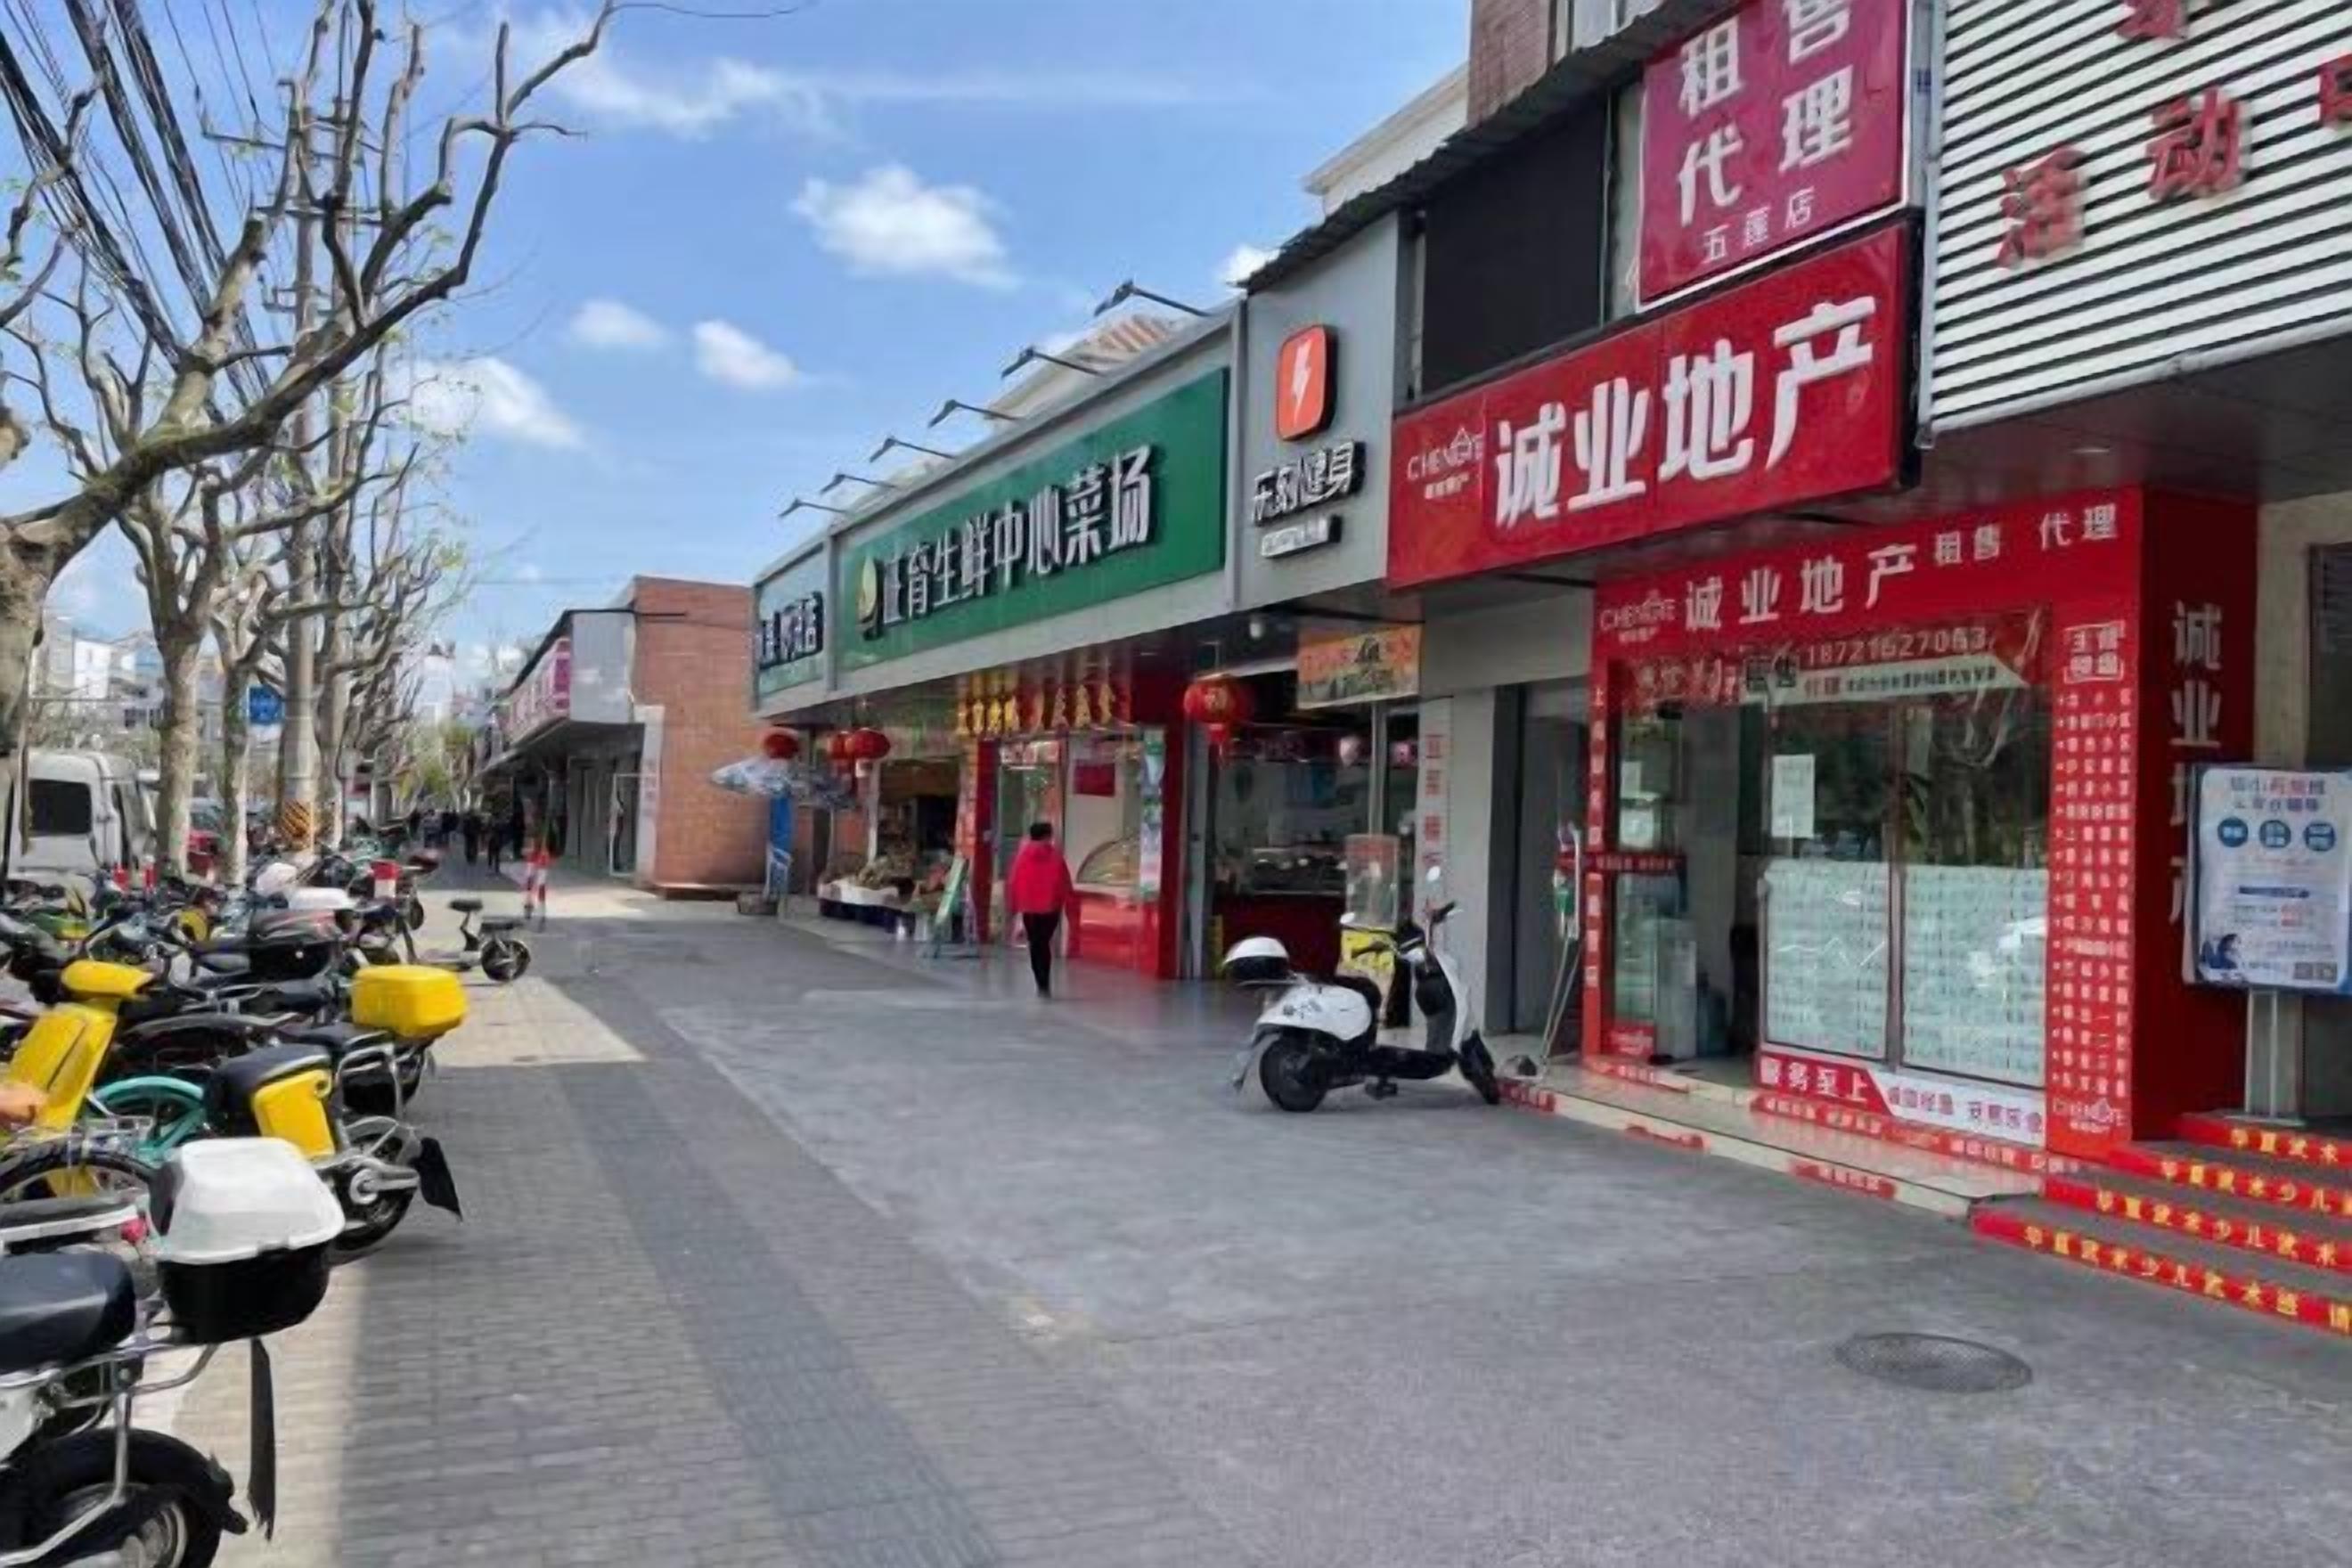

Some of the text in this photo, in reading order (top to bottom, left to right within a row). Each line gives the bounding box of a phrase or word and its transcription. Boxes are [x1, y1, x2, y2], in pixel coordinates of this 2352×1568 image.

[1678, 64, 1853, 227] 代理
[1496, 296, 1876, 528] 诚业地产
[1685, 543, 1918, 632] 诚业地产
[2040, 503, 2117, 551] 代理
